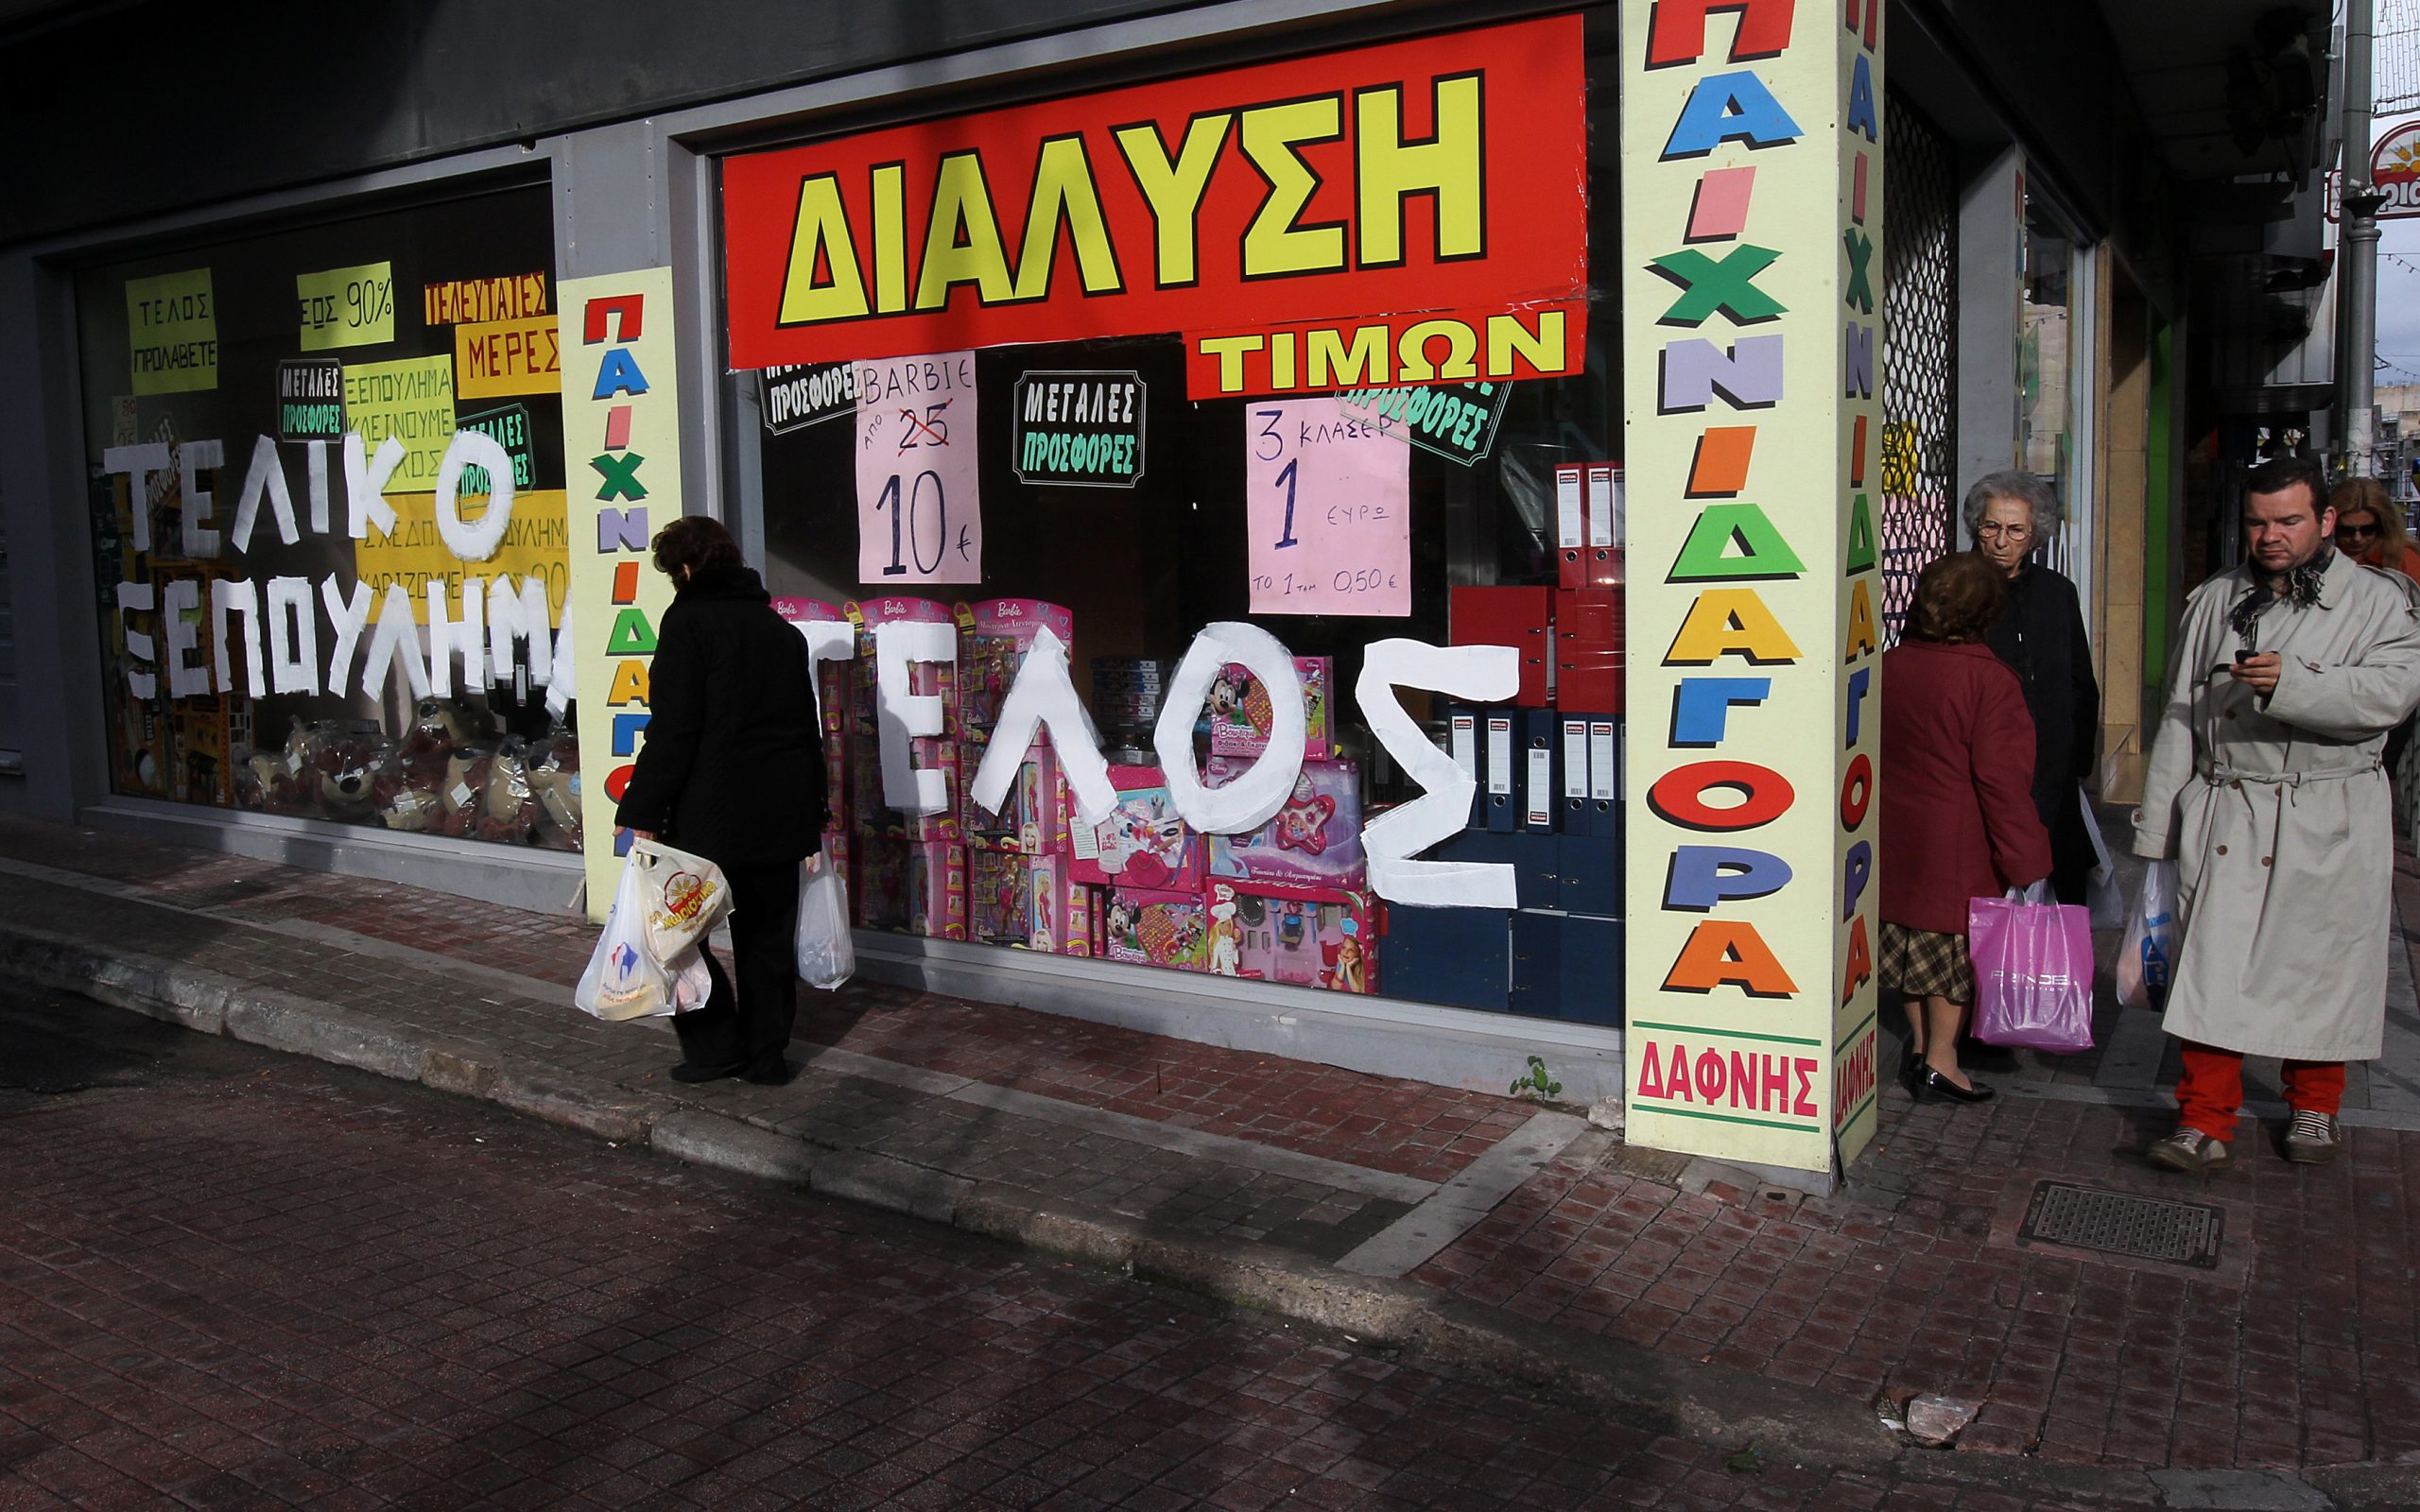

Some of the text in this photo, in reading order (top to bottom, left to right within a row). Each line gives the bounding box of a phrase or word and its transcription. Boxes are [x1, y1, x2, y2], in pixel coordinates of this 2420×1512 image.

[775, 68, 1486, 329] ΔΙΑΛΥΣΗ
[139, 293, 209, 326] ΤΕΛΟΣ
[301, 278, 392, 329] ΕΩΣ 90%
[425, 272, 545, 323] ΤΕΛΕΥΤΑΙΕΣ
[133, 340, 216, 372] ΠΡΟΛΑΒΕΤΕ
[468, 328, 561, 378] ΜΕΡΕΣ
[1201, 311, 1565, 393] ΤΙΜΩΝ
[283, 368, 338, 397] ΜΕΓΑΛΕΣ
[345, 368, 452, 404] ΞΕΠΟΥΛΗΜΑ
[770, 360, 865, 423] ΠΡΟΣΦΟΡΕΣ
[1025, 383, 1134, 422] ΜΕΓΑΛΕΣ
[283, 404, 340, 433] ΠΡΟΣΦΟΡΕΣ
[349, 408, 454, 441] ΚΛΕΙΝΟΥΜΕ
[458, 414, 523, 448] ΑΛΕΣ
[863, 415, 883, 450] ΑΠΟ
[1256, 409, 1283, 460] 3
[365, 450, 442, 480] ΤΛΟΣ
[1022, 432, 1134, 474] ΠΡΟΣΦΟΡΕΣ
[104, 431, 514, 561] ΤΕΛΙΚΟ
[460, 453, 528, 499] ΠΡΟΣΕΣ
[1274, 457, 1298, 550] 1
[1642, 0, 1806, 1000] ΠΑΙΧΝΙΔΑΓΟΡΑ
[364, 516, 569, 548] ΣΧΕΔΟ ΟΥΛΗΜ
[876, 470, 945, 576] 10
[583, 294, 658, 857] ΠΑΙΧΝΙΔΑΓ
[1253, 576, 1272, 590] ΤΟ
[1284, 572, 1293, 595] 1
[1334, 568, 1382, 593] 0,50
[777, 600, 798, 615] Barbie
[884, 599, 908, 616] Barbie
[997, 601, 1023, 617] Barbie
[1637, 1040, 1818, 1118] ΔΑΦΝΗΣ
[1835, 1029, 1876, 1129] ΔΑΦΝΗΣ
